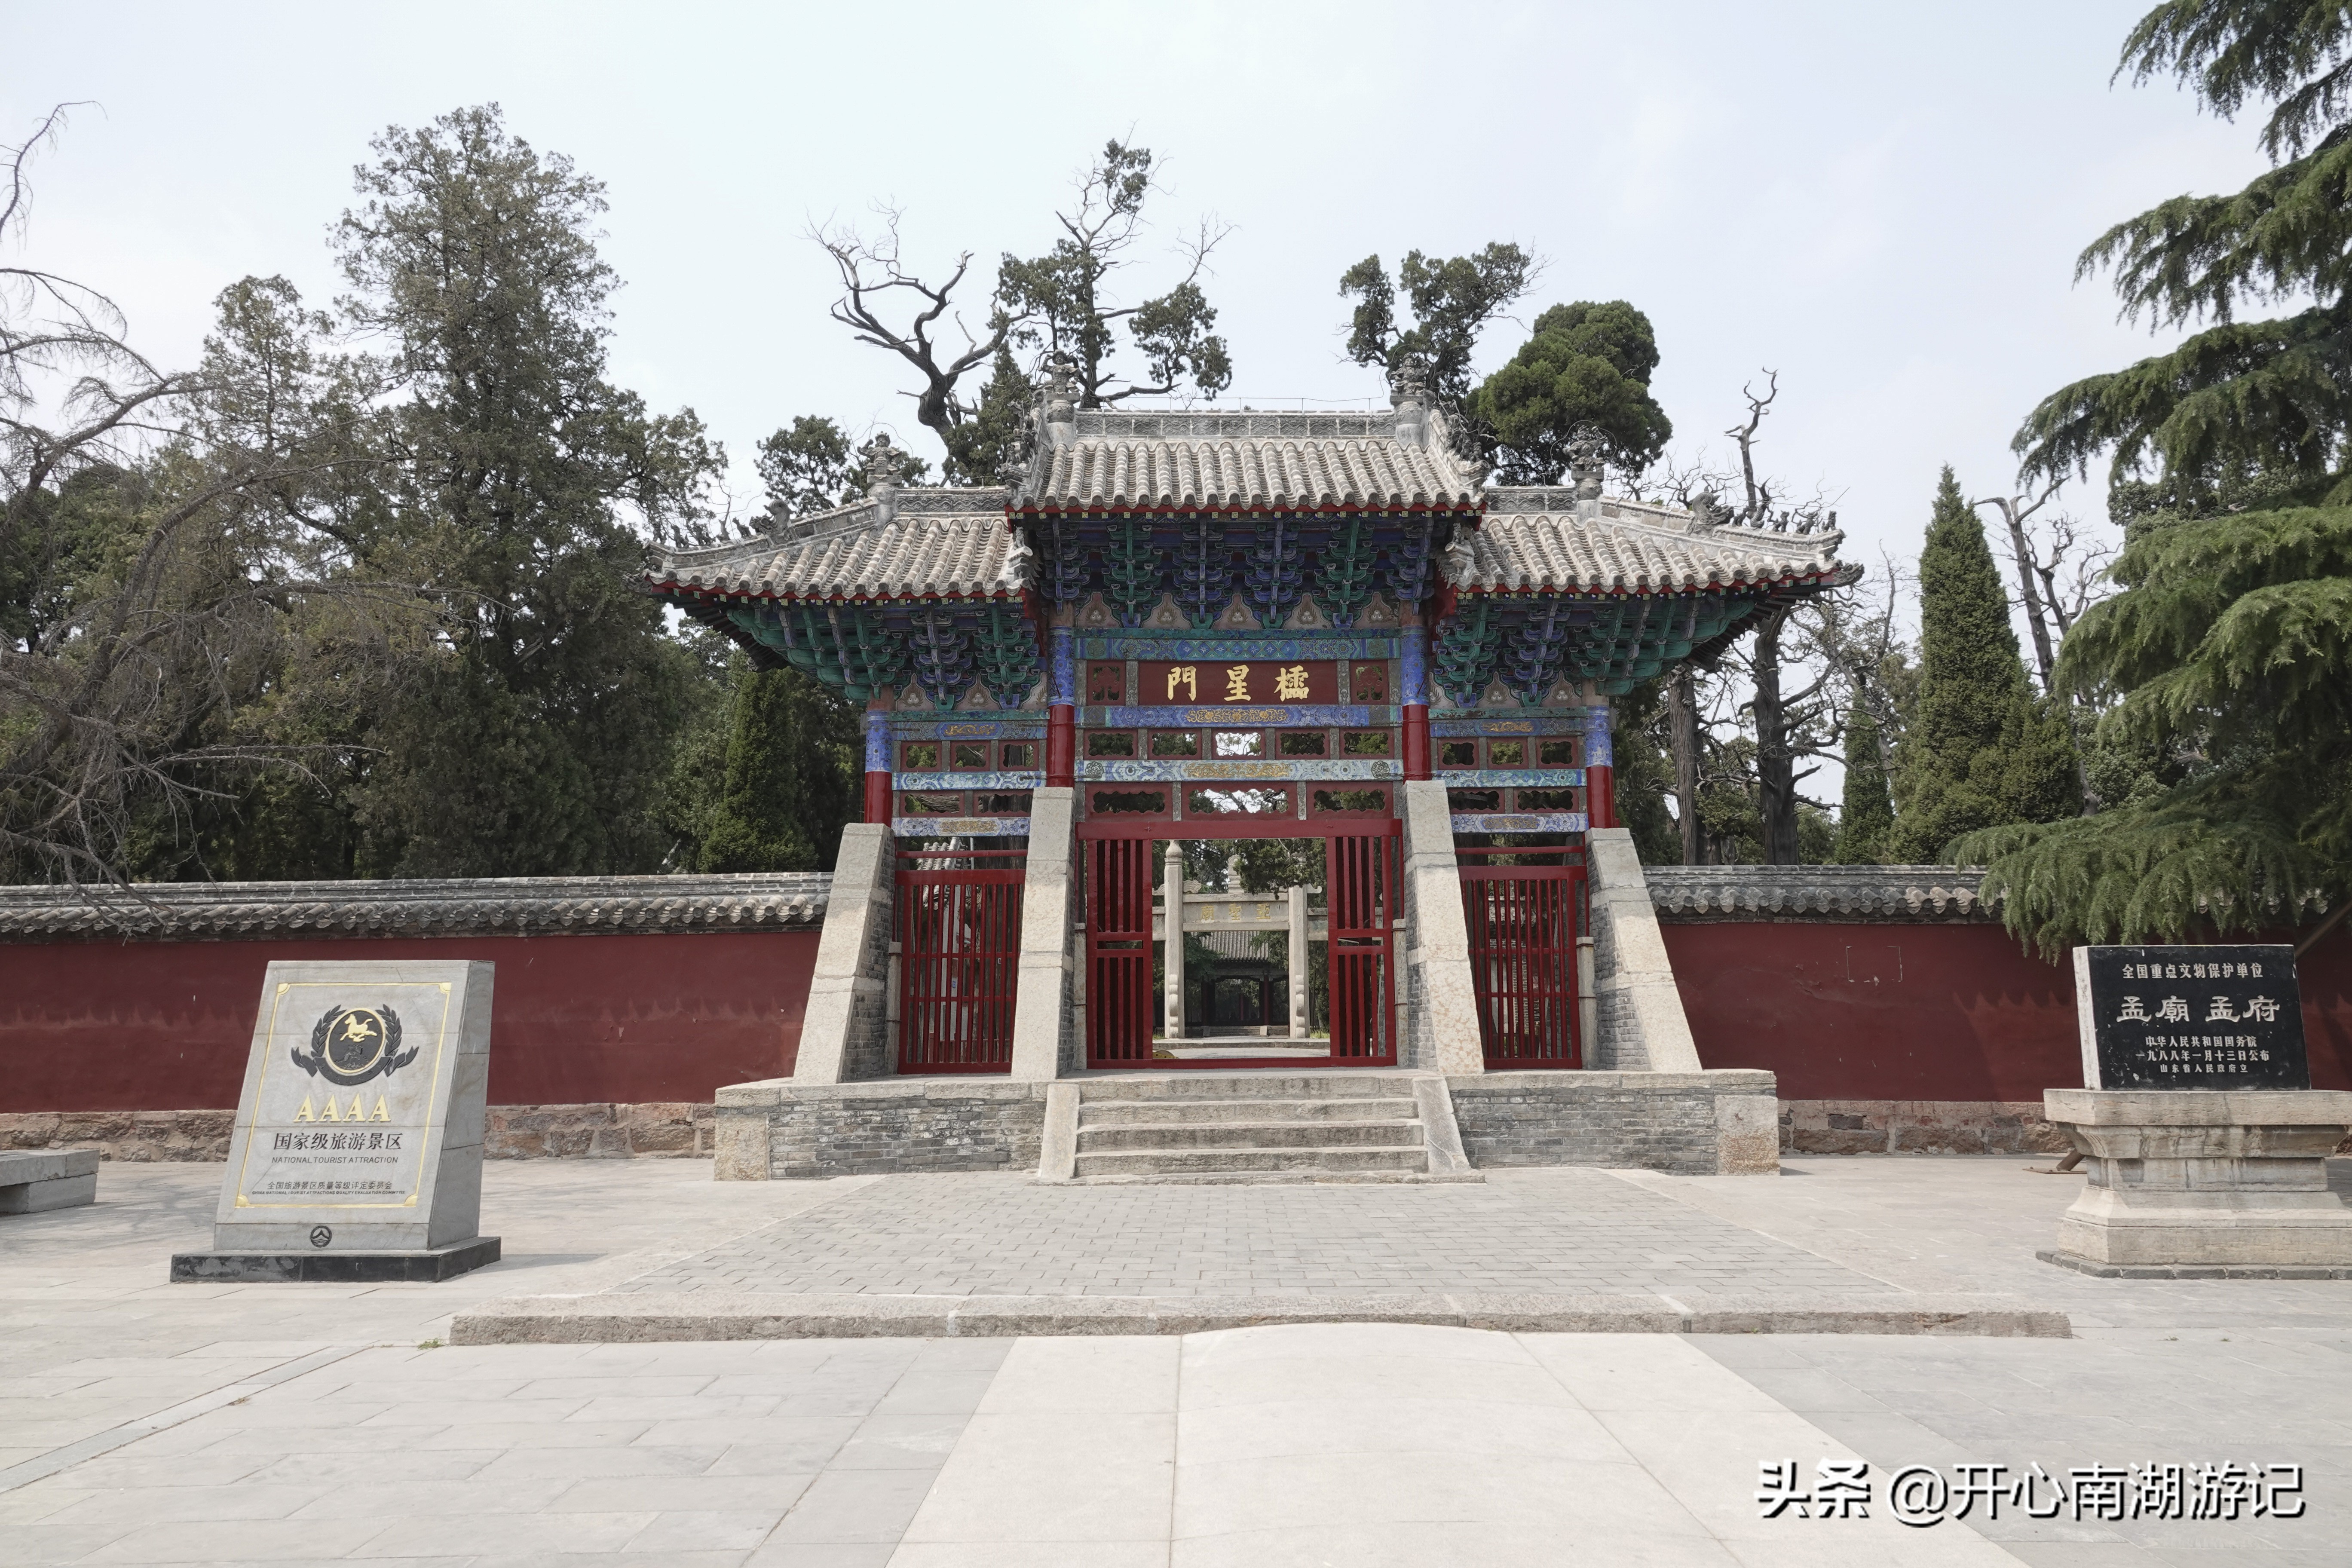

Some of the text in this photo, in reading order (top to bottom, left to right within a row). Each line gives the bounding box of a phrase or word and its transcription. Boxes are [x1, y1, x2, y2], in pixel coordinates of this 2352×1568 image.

[2122, 962, 2263, 979] 全国重点文物保护单位
[2205, 995, 2280, 1023] 孟府
[2145, 1035, 2257, 1047] 中华人民共和国国务院
[2135, 1049, 2269, 1062] 一九八八年一月十三日公布
[2160, 1063, 2248, 1073] 山东省人民政府立
[293, 1093, 392, 1122] AAAA
[273, 1133, 403, 1151] 国家级旅游景区
[267, 1181, 392, 1190] 全国旅游景区质量等级评定委员会
